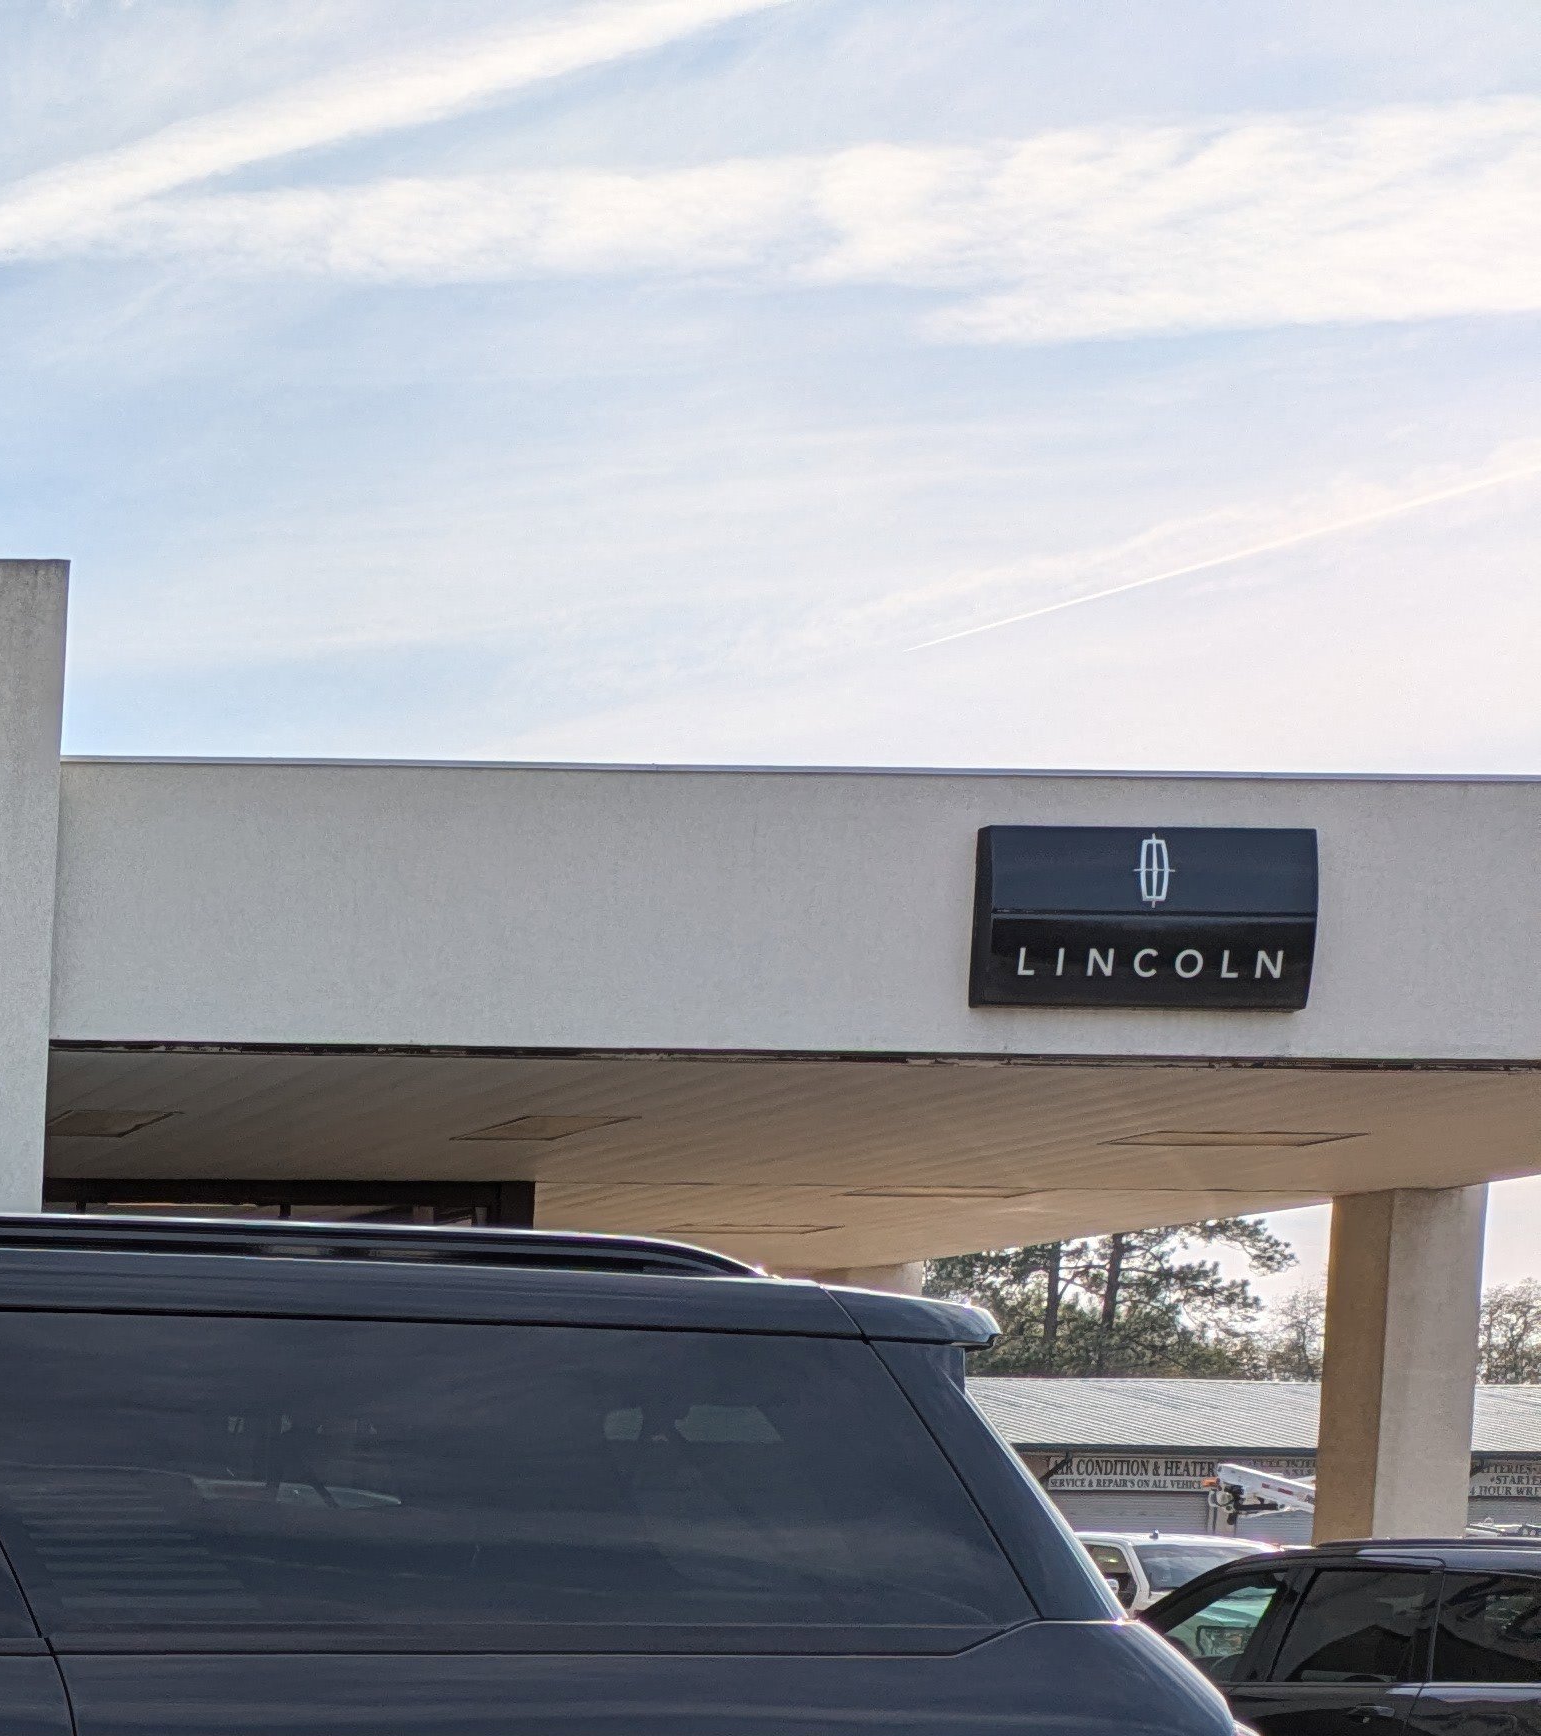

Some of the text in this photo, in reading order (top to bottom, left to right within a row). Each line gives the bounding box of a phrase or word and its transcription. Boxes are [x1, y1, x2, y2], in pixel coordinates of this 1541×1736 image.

[1017, 947, 1284, 979] LINCOLN
[1077, 1459, 1149, 1476] CONDITION
[1153, 1460, 1160, 1476] &
[1164, 1460, 1216, 1477] HEATER
[1050, 1478, 1086, 1488] SERVICE
[1137, 1479, 1150, 1488] ON
[1152, 1479, 1168, 1488] ALL
